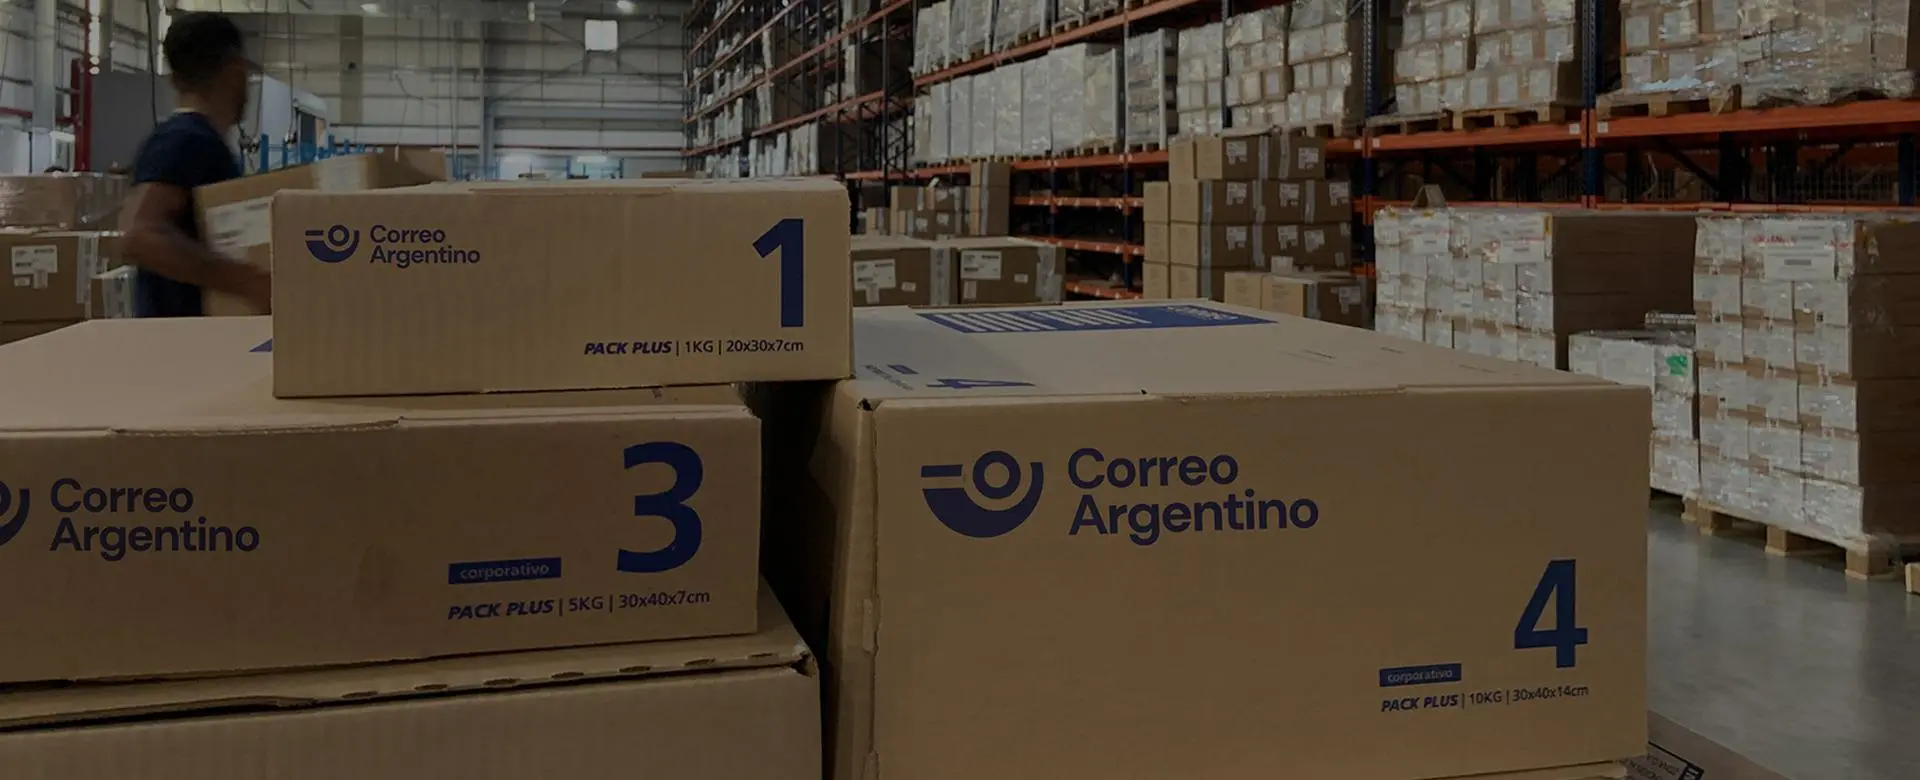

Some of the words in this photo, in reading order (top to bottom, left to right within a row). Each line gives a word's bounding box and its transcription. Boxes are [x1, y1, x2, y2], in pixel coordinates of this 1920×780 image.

[370, 224, 445, 243] Correo
[369, 245, 480, 269] Argentino
[752, 218, 804, 327] 1
[584, 342, 629, 356] PACK
[632, 340, 673, 354] PLUS
[684, 340, 714, 353] 1KG
[725, 339, 805, 353] 20x30x7cm
[1067, 447, 1239, 489] Correo
[50, 478, 194, 513] Correo
[616, 441, 703, 573] 3
[1068, 488, 1320, 546] Argentino
[49, 516, 260, 562] Argentino
[459, 560, 550, 581] corporativo
[447, 603, 501, 620] PACK
[505, 599, 555, 616] PLUS
[568, 596, 604, 611] 5KG
[618, 590, 711, 609] 30x40x7cm
[1514, 559, 1588, 668] 4
[1386, 667, 1453, 684] corporativo
[1380, 697, 1420, 713] PACK
[1423, 693, 1459, 709] PLUS
[1470, 691, 1503, 705] 10KG
[1513, 685, 1590, 702] 30x40x14cm
